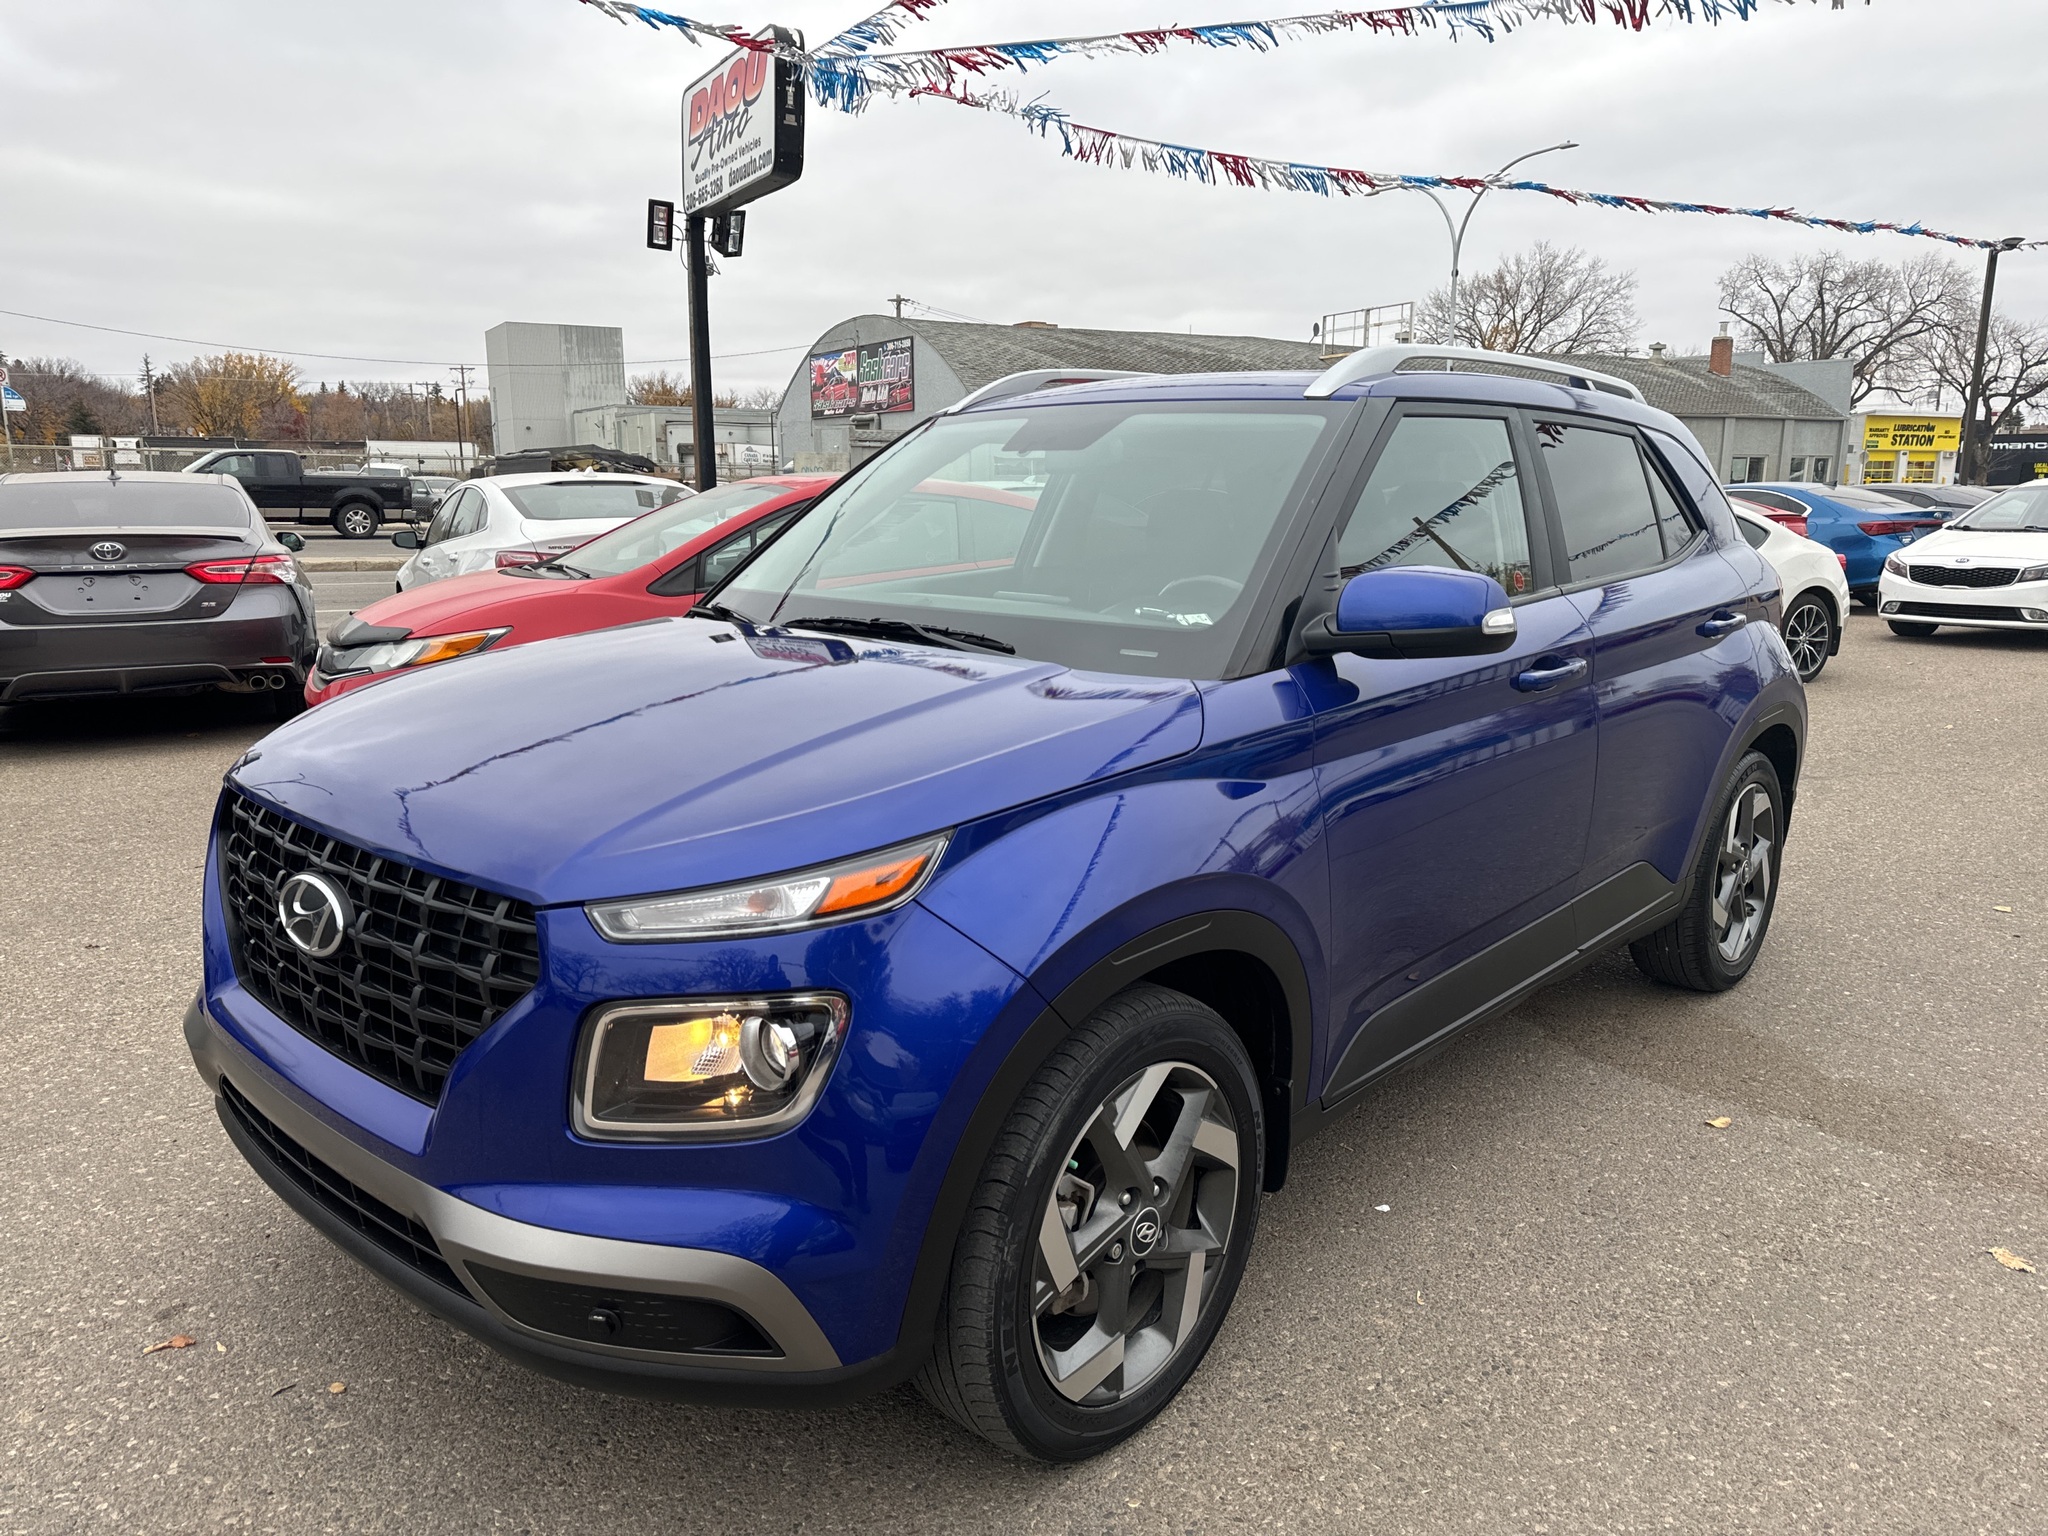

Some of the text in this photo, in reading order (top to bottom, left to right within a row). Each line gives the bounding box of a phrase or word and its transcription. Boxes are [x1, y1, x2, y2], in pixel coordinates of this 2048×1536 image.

[688, 50, 768, 147] DAOU
[691, 107, 752, 171] Auto
[695, 137, 761, 184] Quality Pre-Owned Vehicles
[728, 148, 773, 188] daouauto.com
[1891, 434, 1935, 447] STATION
[61, 562, 160, 570] CAMRY
